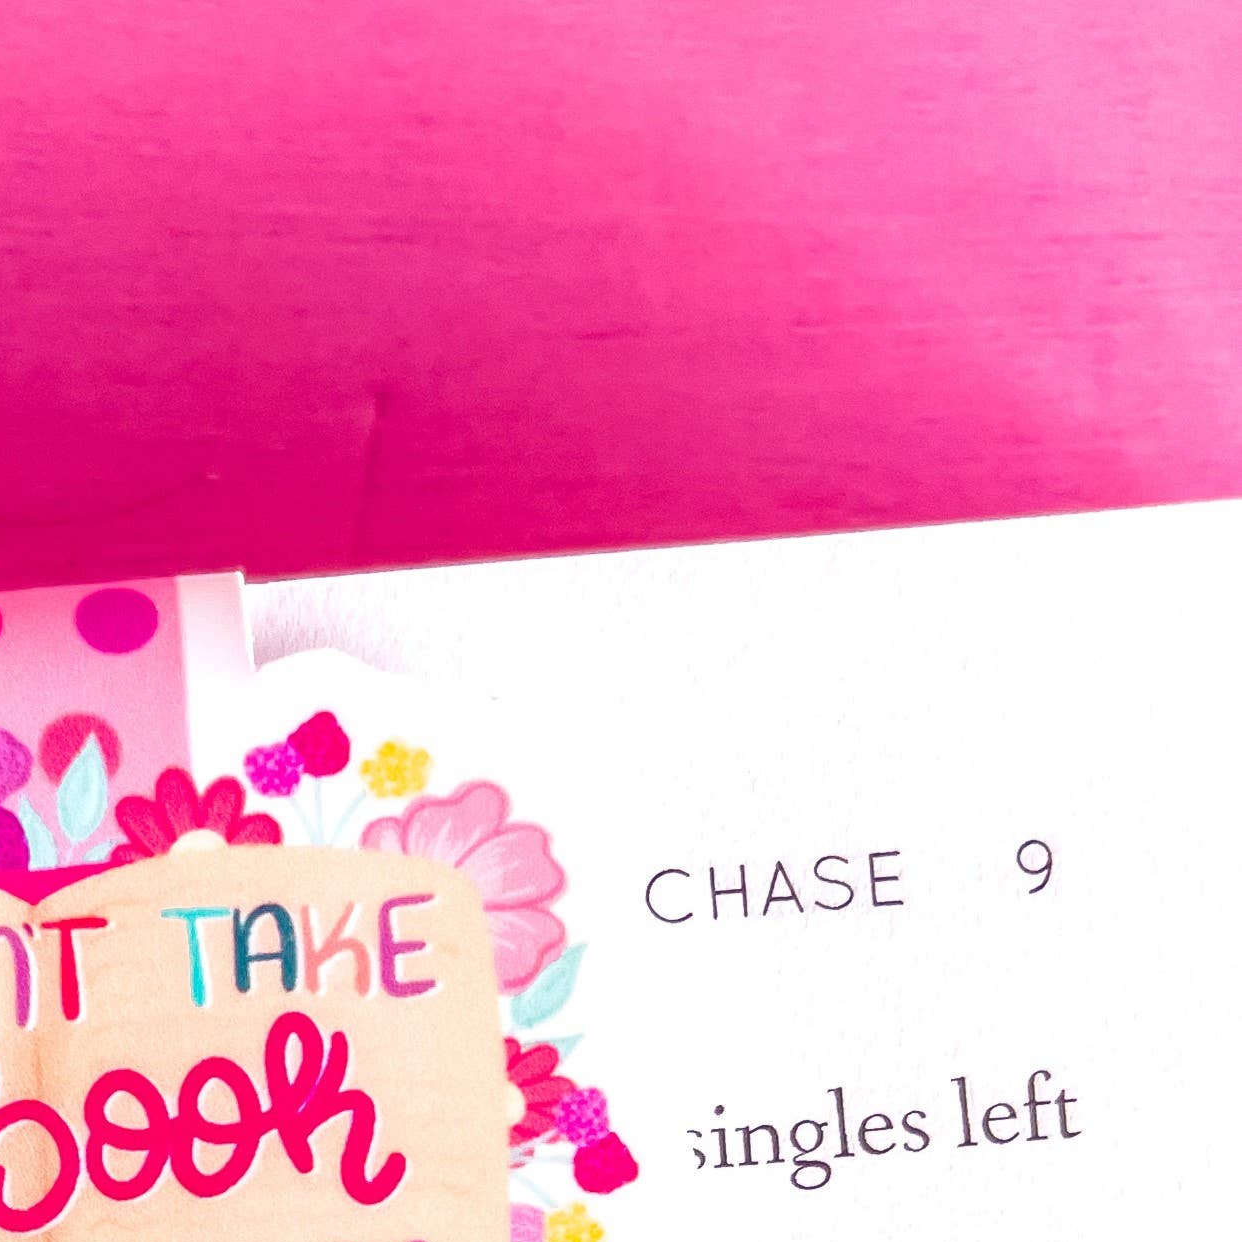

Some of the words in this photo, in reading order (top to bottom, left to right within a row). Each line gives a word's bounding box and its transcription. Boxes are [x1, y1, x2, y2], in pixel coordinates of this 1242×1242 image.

[646, 851, 903, 923] CHASE
[1017, 840, 1052, 893] 9
[161, 893, 435, 1007] TAKE
[951, 1070, 1081, 1147] left
